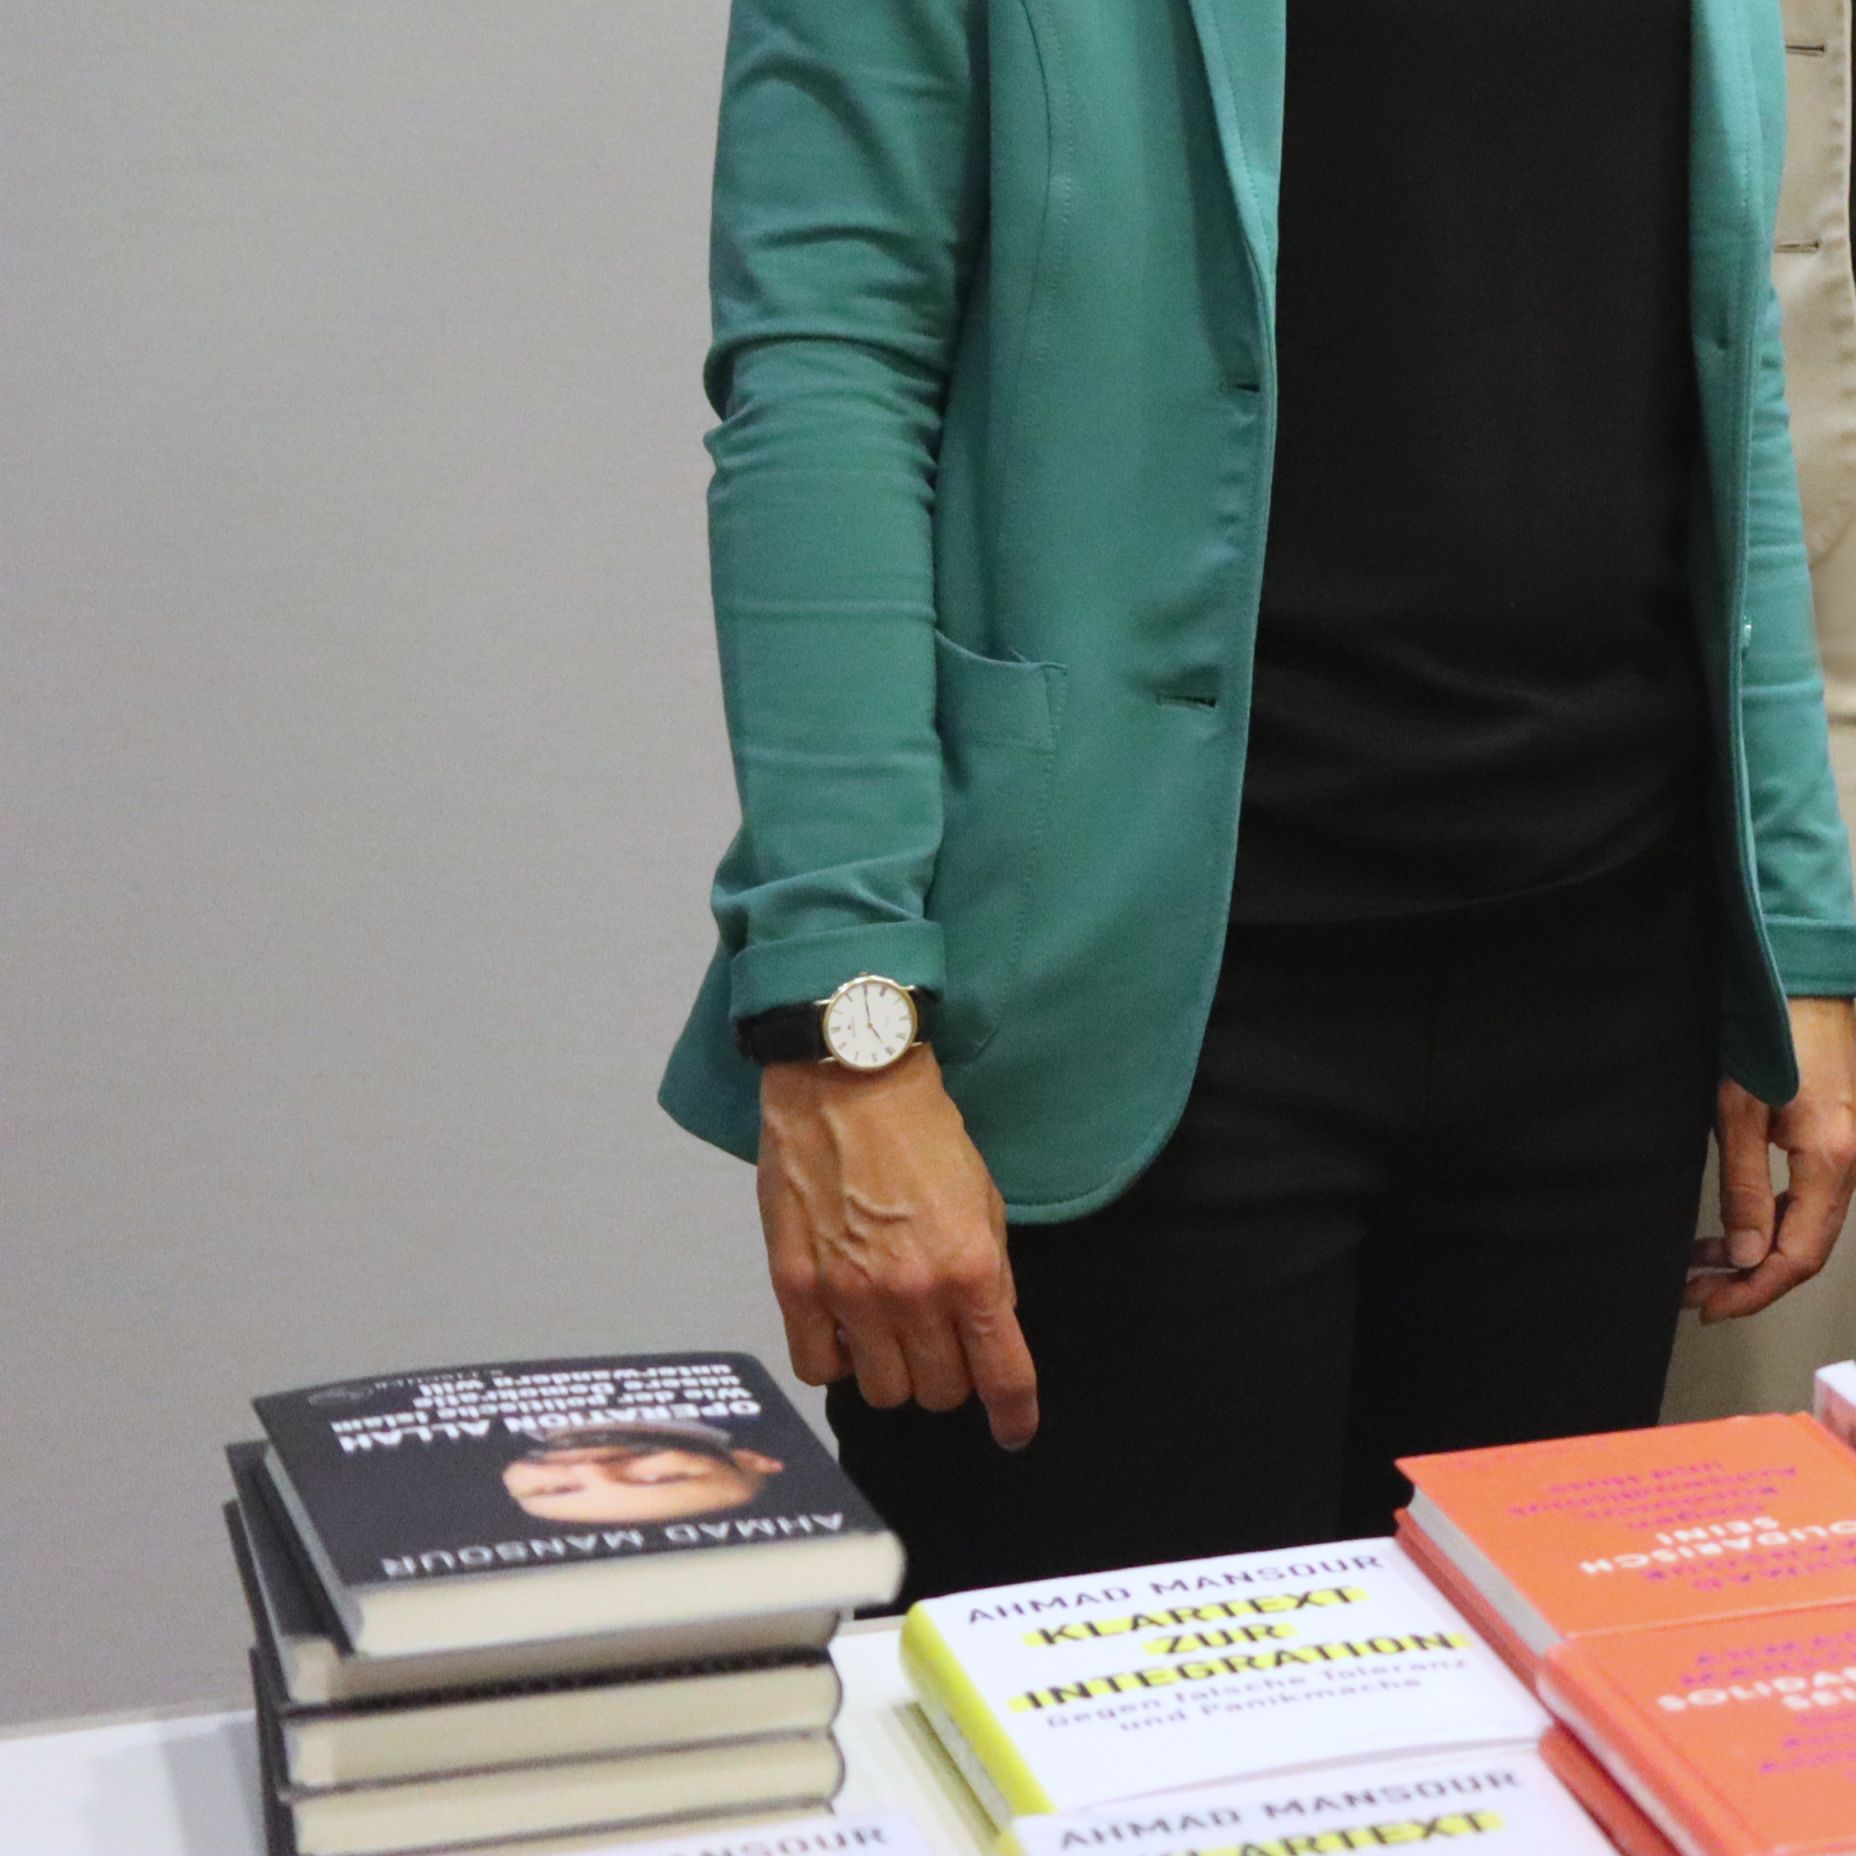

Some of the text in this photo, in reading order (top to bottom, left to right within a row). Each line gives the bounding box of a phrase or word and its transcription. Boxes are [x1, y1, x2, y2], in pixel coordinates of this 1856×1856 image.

[339, 1399, 762, 1453] OPERATION ALLAH
[381, 1512, 845, 1577] AHMAD MANSOUR
[967, 1554, 1387, 1626] AHMAD MANSOUR
[1037, 1586, 1357, 1646] KLARTEXT
[1162, 1623, 1280, 1655] ZUR
[1023, 1632, 1460, 1711] INTEGRATION
[1045, 1697, 1163, 1731] Gegen
[1173, 1673, 1308, 1707] falsche
[1120, 1679, 1423, 1734] und Panikmache
[1060, 1771, 1521, 1850] AHMAD MANSOUR
